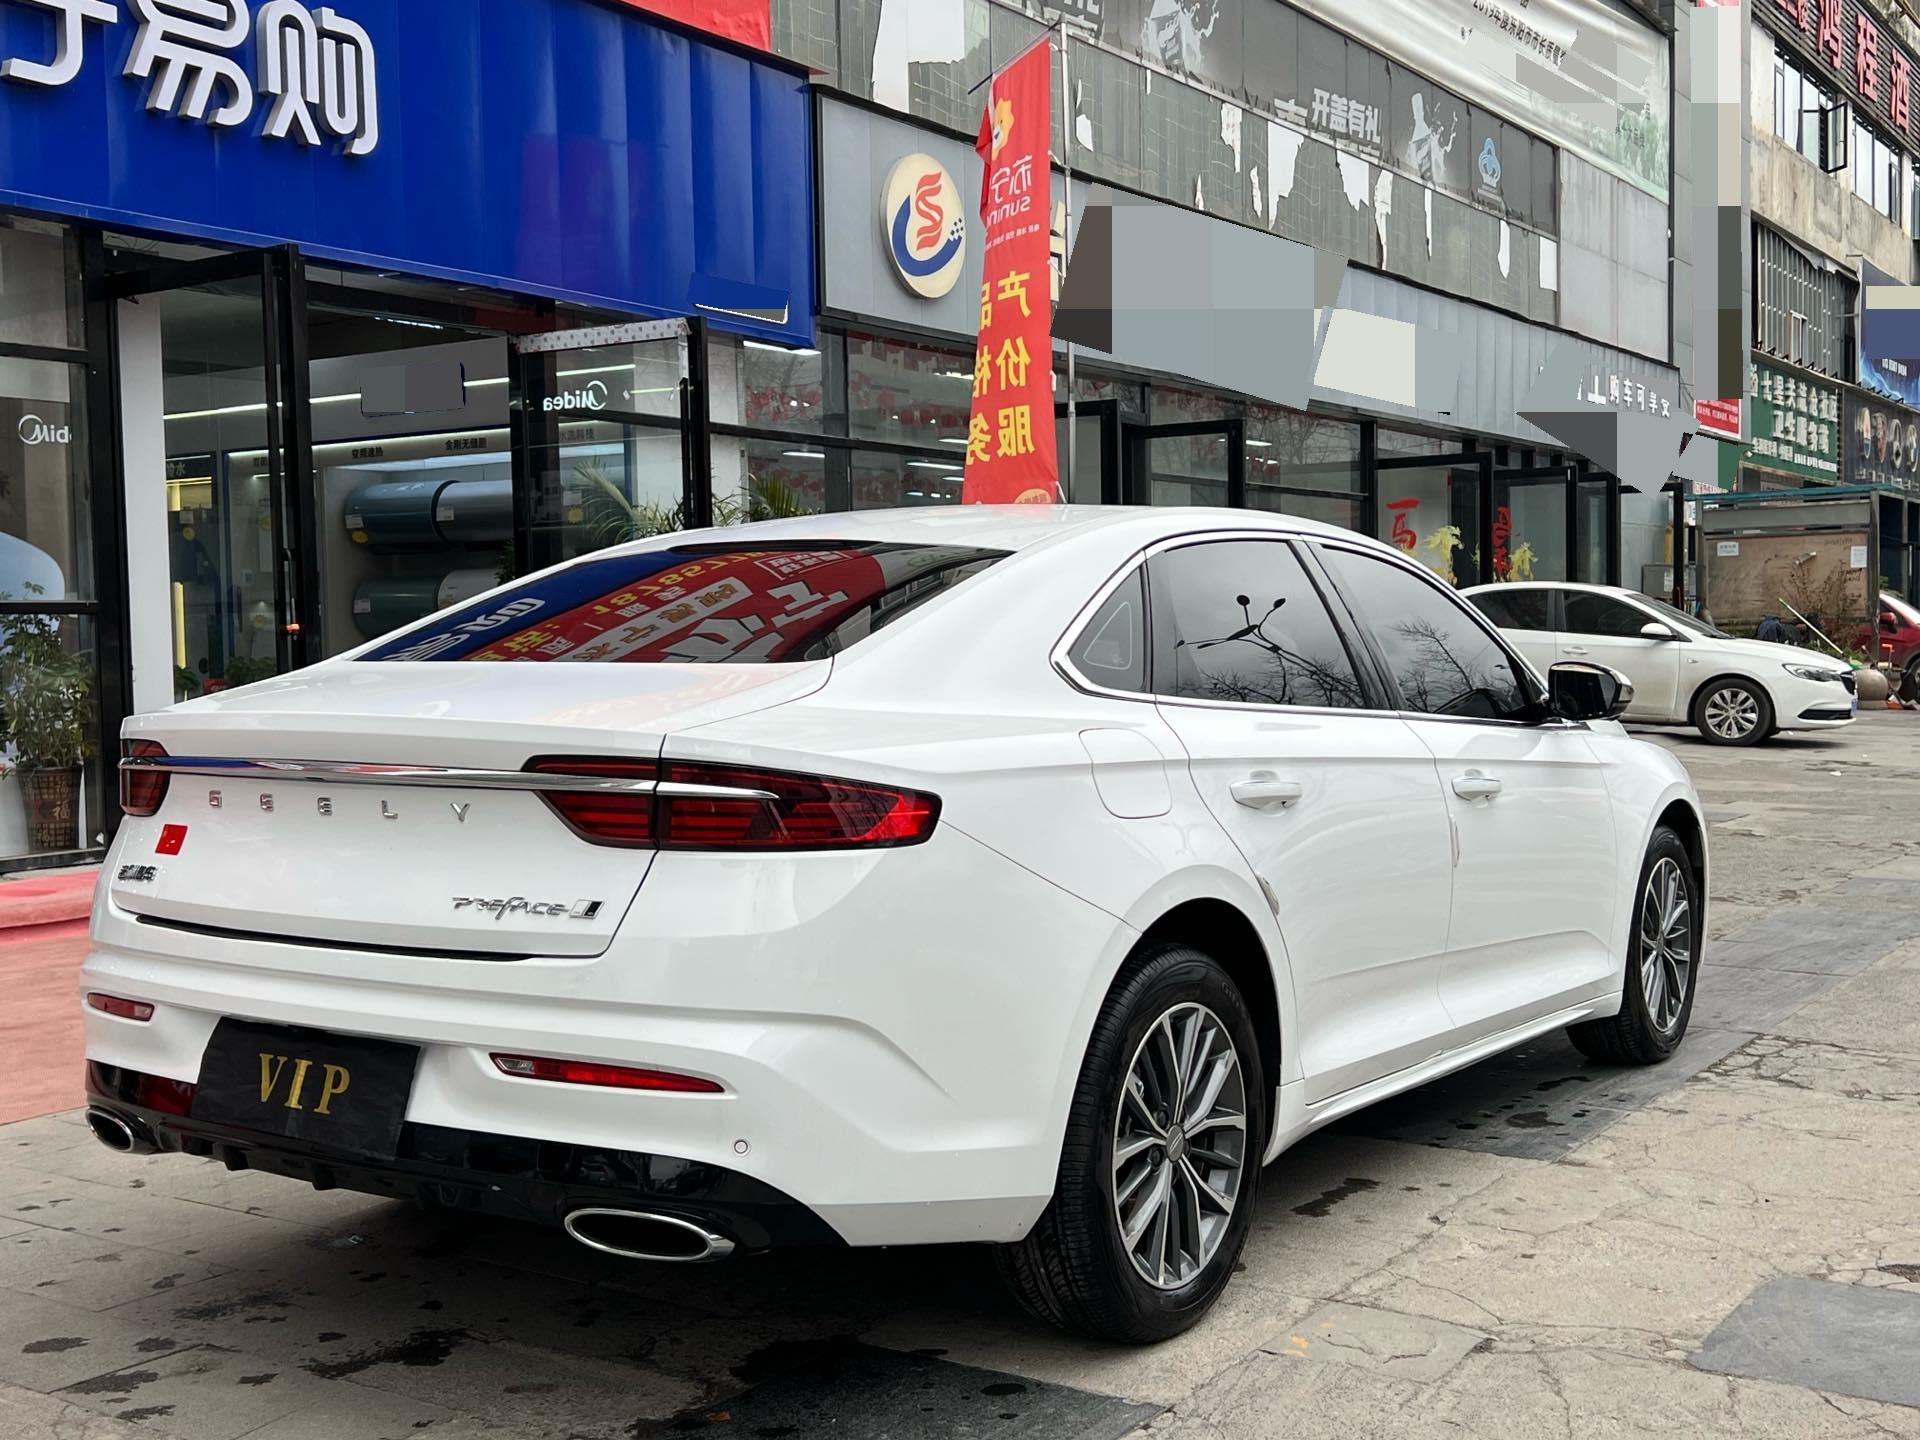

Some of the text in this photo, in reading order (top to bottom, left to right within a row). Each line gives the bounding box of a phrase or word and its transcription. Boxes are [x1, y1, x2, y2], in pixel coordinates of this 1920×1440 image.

[1312, 88, 1381, 144] 开盖有礼
[208, 789, 471, 822] GEELY
[259, 1053, 350, 1115] VIP
